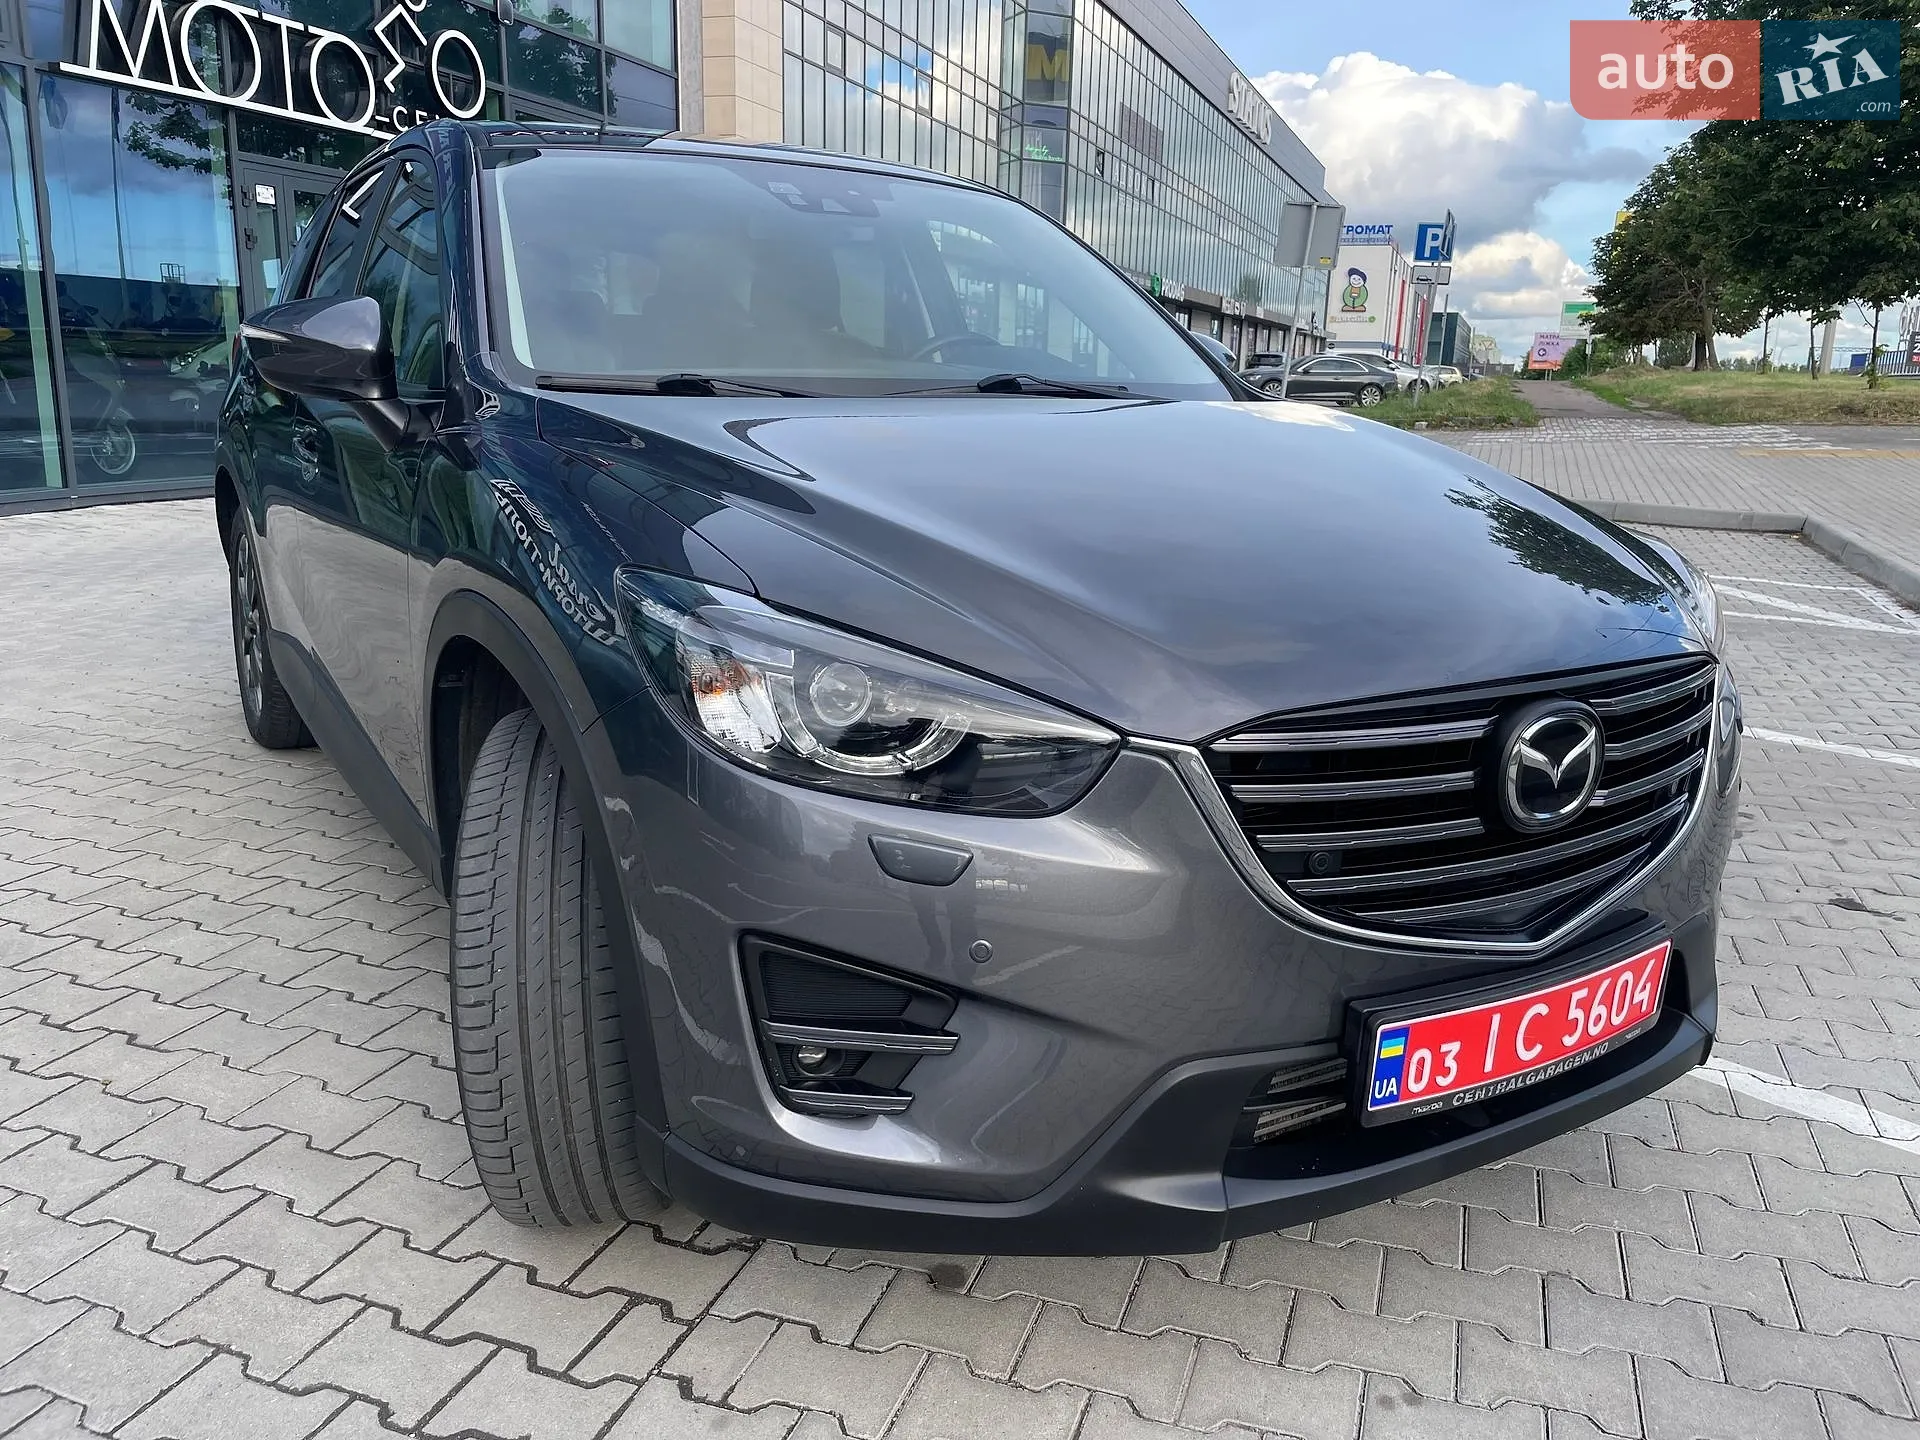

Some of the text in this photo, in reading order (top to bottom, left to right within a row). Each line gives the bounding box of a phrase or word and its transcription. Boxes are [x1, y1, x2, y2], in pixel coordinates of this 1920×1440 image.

[1423, 227, 1443, 258] P
[1374, 1077, 1398, 1099] UA
[1406, 1041, 1461, 1094] 03
[1561, 957, 1656, 1048] 5604
[1451, 1041, 1609, 1107] CENTRALGARAGEN.NO
